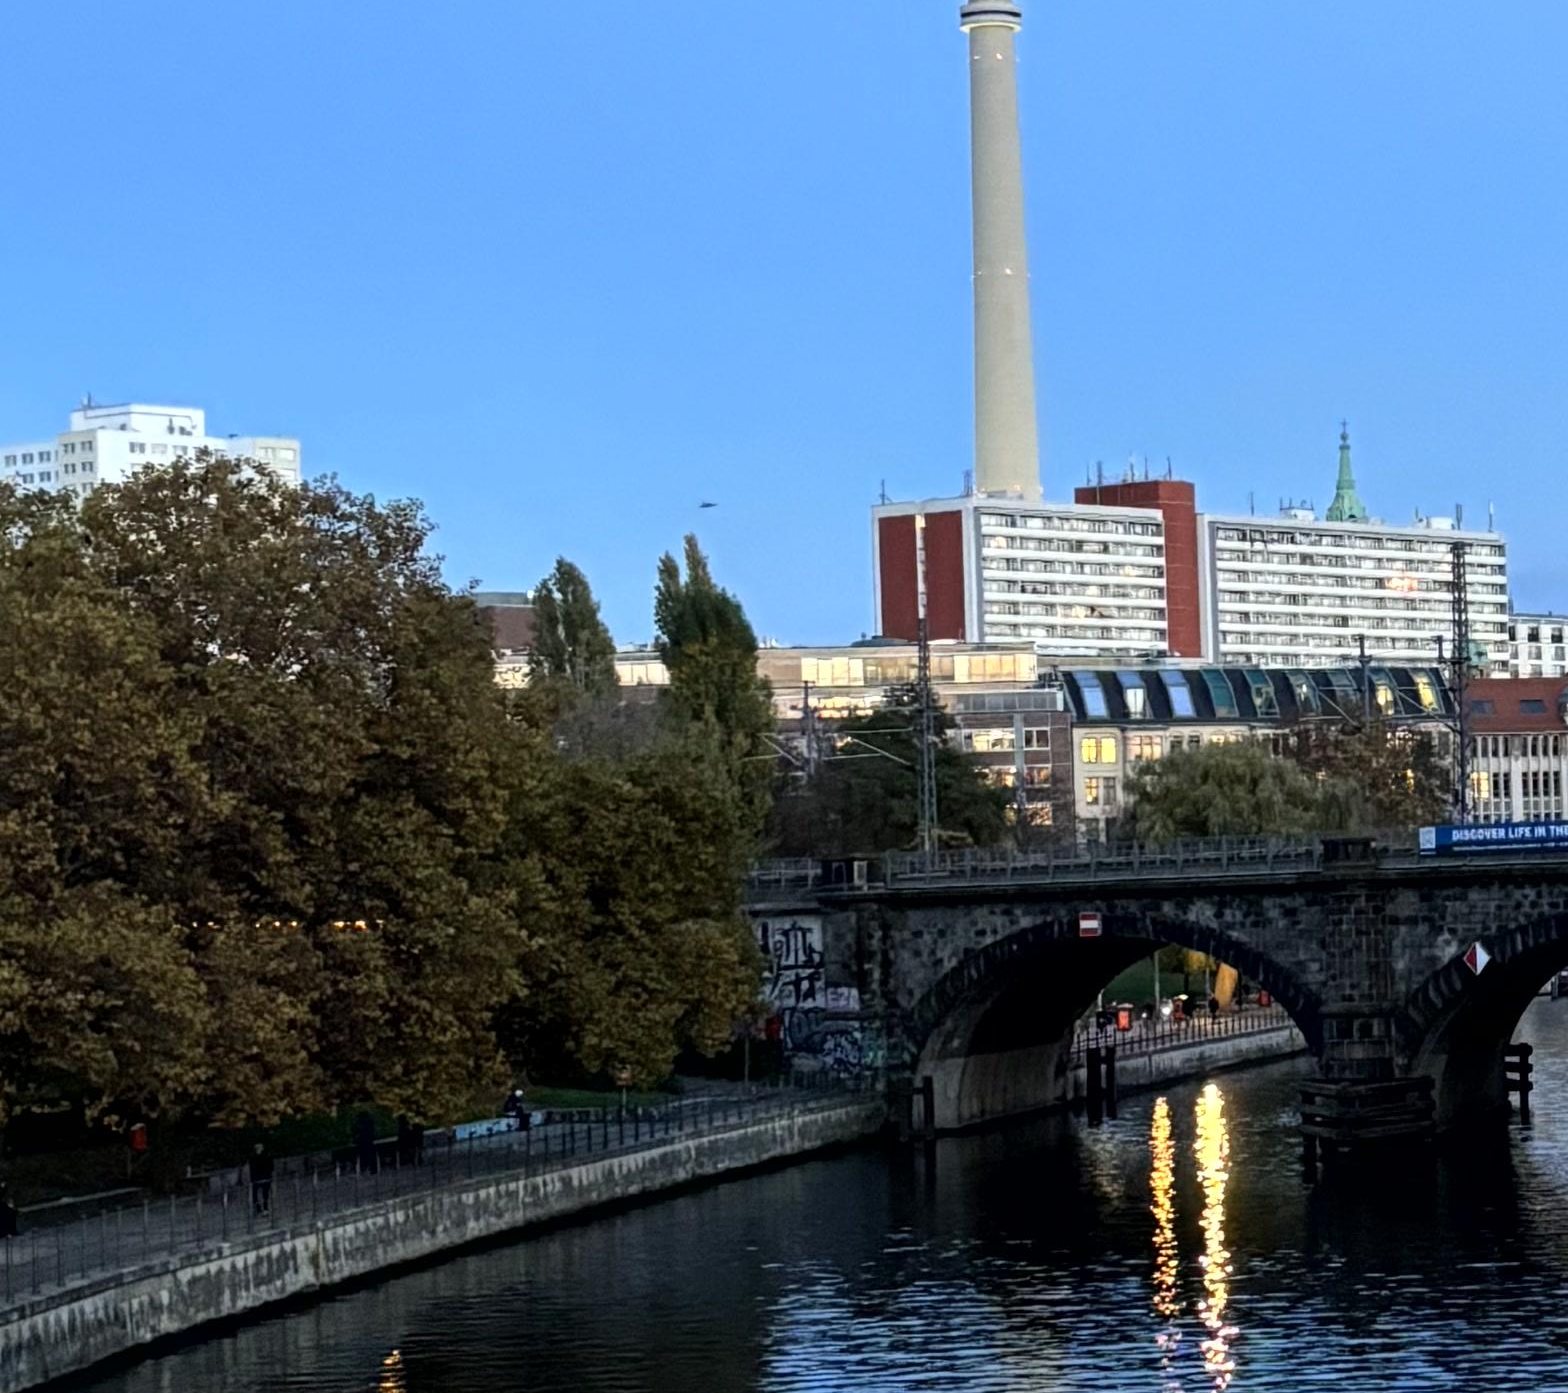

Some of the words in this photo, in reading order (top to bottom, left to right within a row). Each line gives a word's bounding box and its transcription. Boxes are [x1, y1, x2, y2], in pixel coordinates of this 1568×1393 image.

[1452, 827, 1506, 841] DISCOVER
[1508, 826, 1531, 839] LIFE
[1534, 825, 1547, 837] IN
